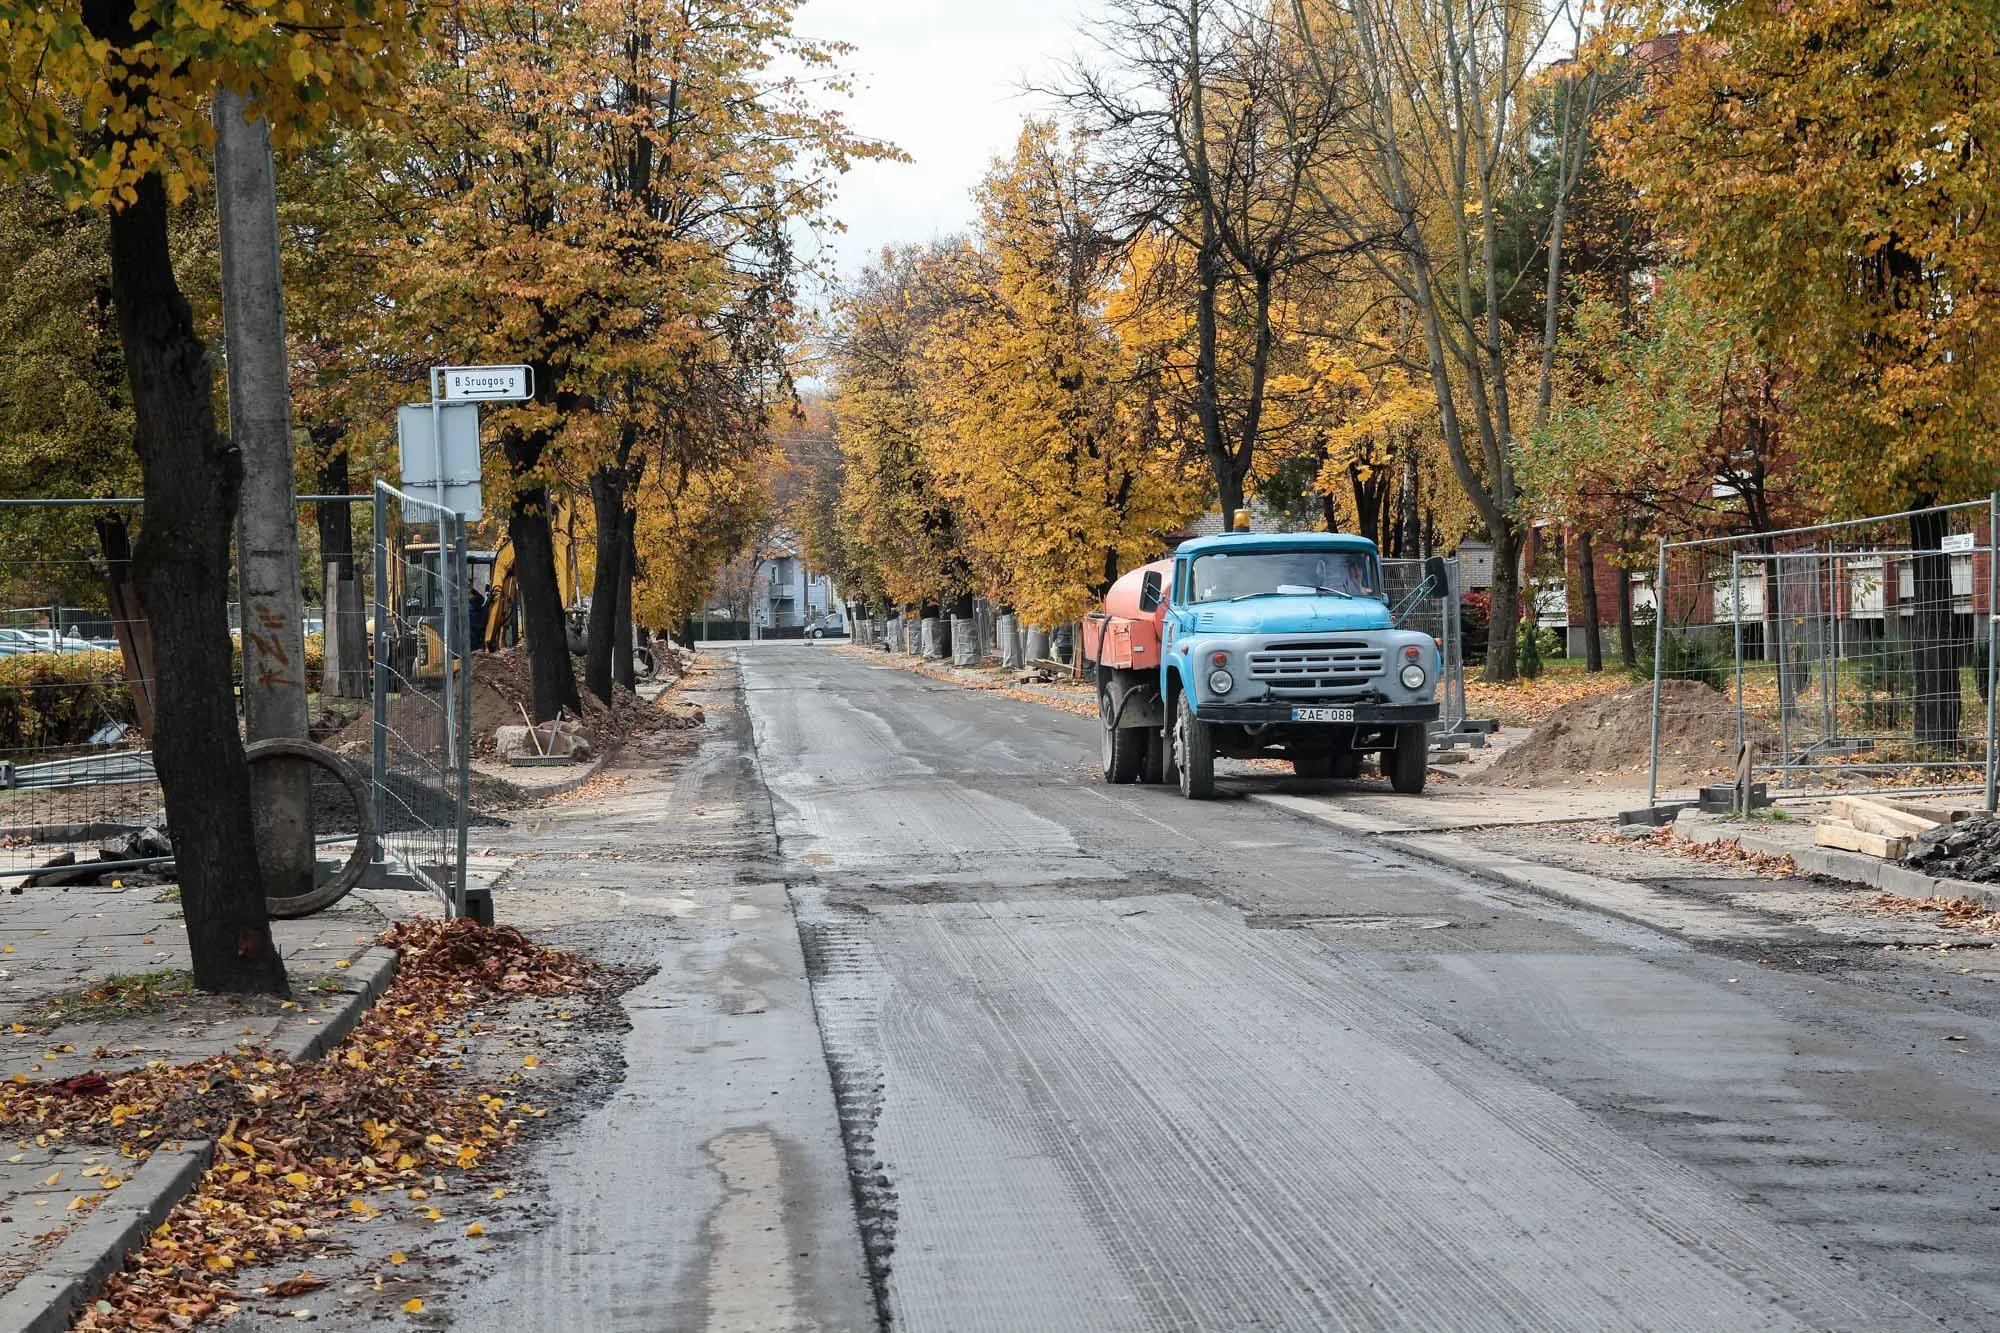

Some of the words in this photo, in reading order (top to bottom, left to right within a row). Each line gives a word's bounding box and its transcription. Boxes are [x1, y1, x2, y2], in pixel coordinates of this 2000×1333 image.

[465, 376, 504, 388] Sruogos
[1299, 709, 1323, 721] ZAE
[1331, 710, 1352, 721] 088
